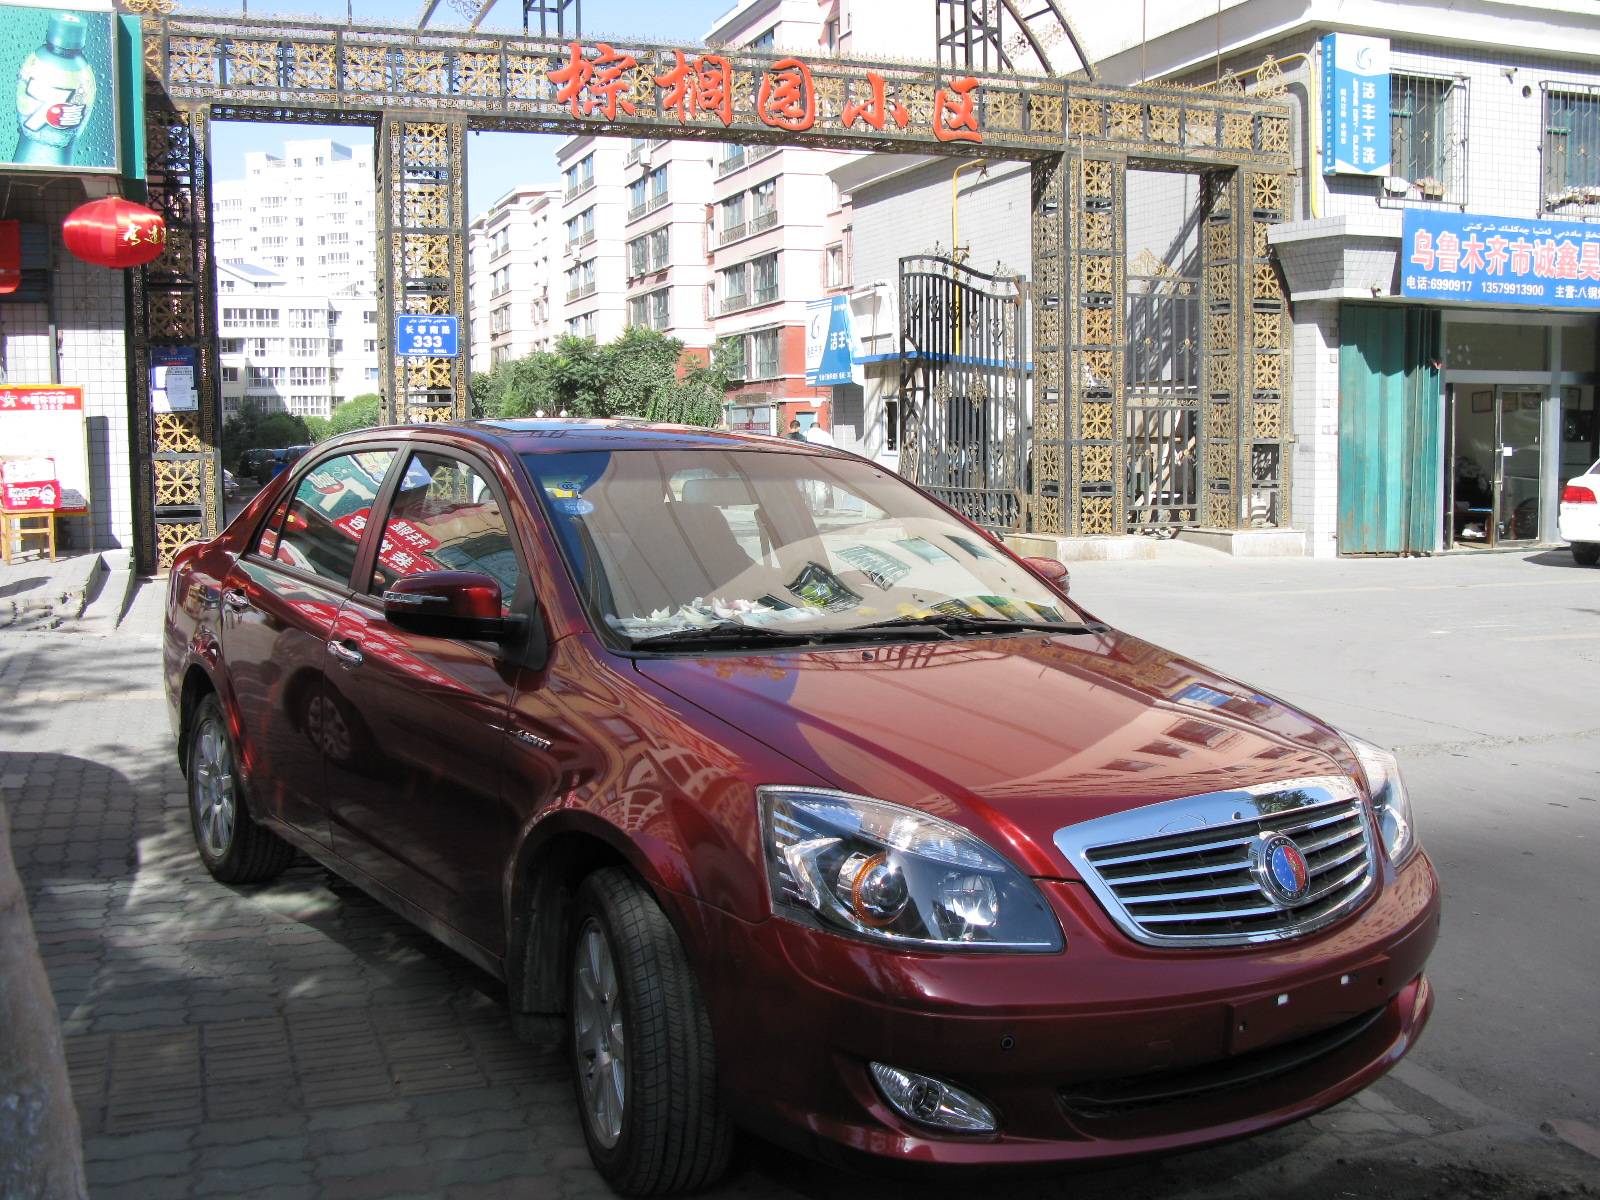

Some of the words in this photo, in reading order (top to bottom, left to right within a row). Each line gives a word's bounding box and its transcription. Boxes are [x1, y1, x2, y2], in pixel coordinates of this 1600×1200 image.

[547, 42, 983, 143] 棕榈园小区
[1362, 82, 1376, 164] 洁丰干洗
[1481, 282, 1544, 296] 13579913900
[405, 325, 451, 334] 长春南路
[413, 335, 442, 347] 333
